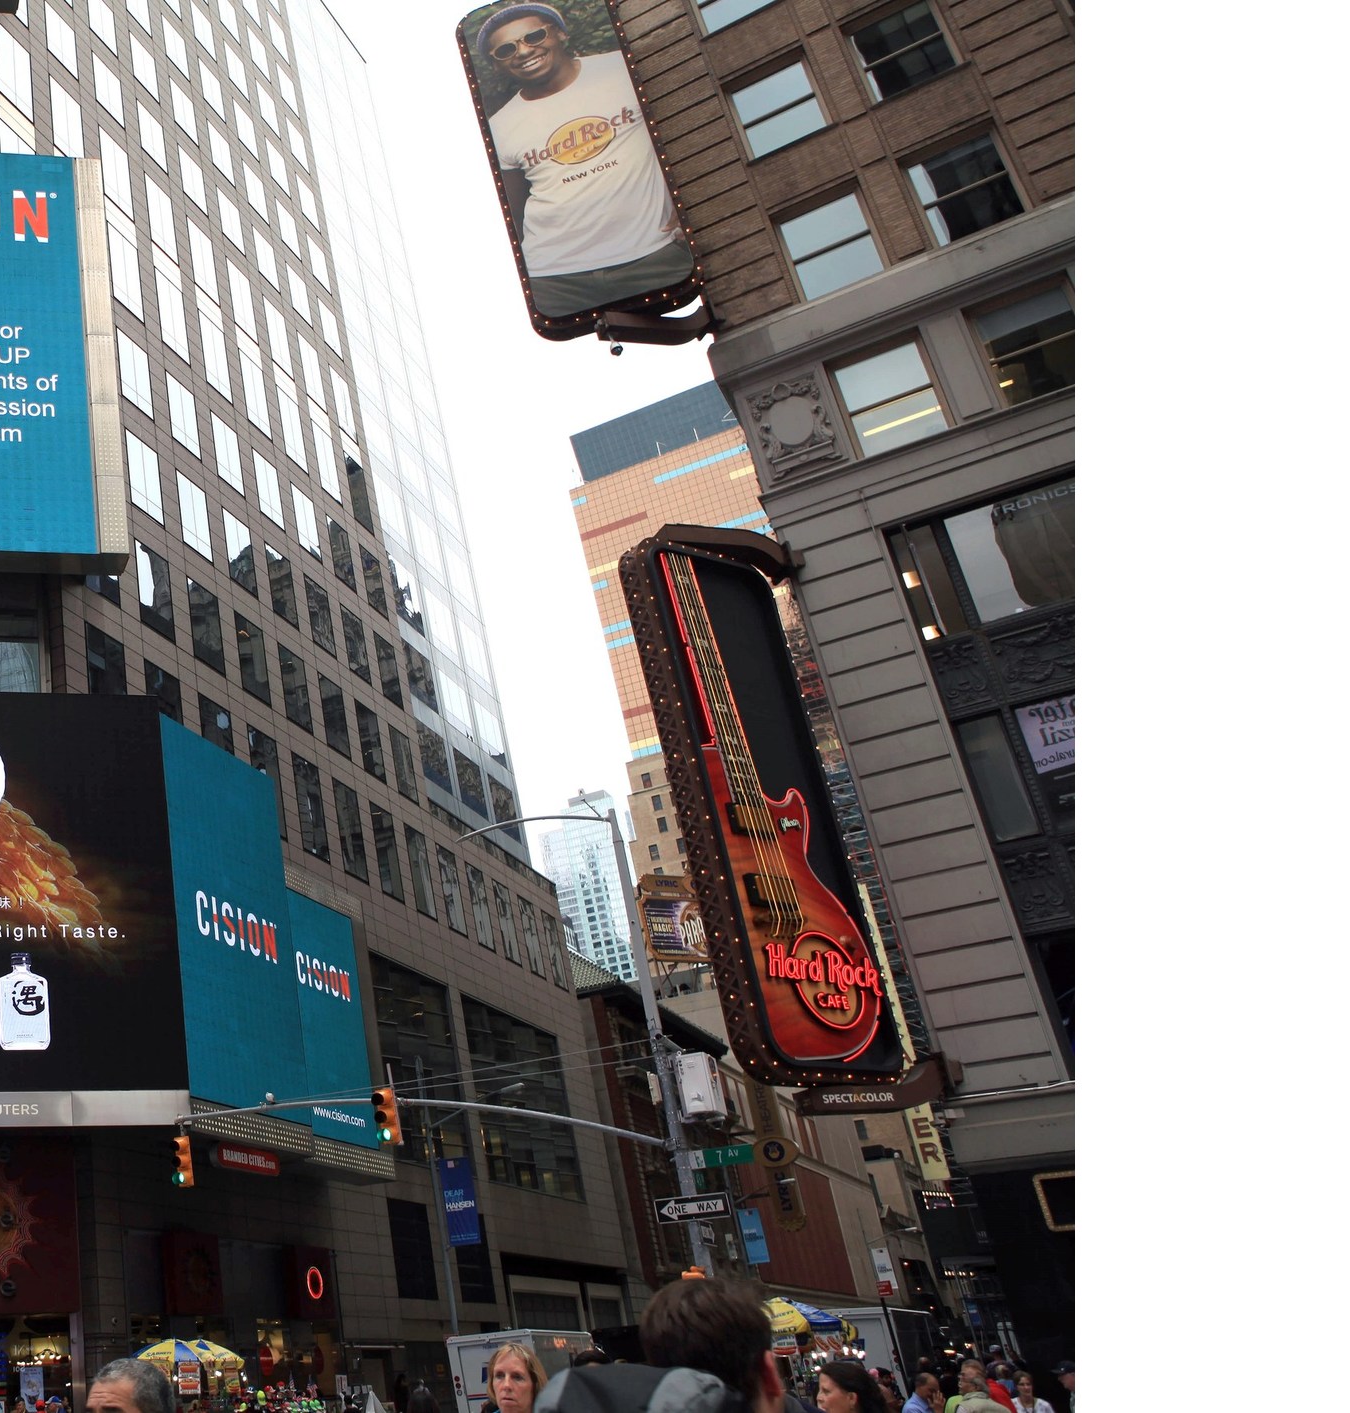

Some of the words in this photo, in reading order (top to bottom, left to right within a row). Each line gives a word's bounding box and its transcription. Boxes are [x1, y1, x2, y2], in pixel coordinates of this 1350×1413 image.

[523, 130, 577, 167] Hard
[578, 106, 636, 143] Rock
[562, 171, 588, 184] NEW
[590, 160, 619, 174] YORK
[36, 374, 59, 392] of
[655, 880, 679, 888] LYRIC
[58, 923, 126, 939] Taste.
[679, 916, 707, 948] PARA
[765, 943, 822, 983] Hard
[825, 951, 883, 996] Rock
[816, 992, 850, 1011] CAFE
[822, 1092, 895, 1104] SPECTACOLOR
[312, 1106, 366, 1128] www.cision.com
[222, 1148, 249, 1164] BRANDED
[716, 1150, 723, 1163] 7
[444, 1189, 464, 1198] DEAR
[446, 1200, 475, 1210] HANSEN
[667, 1204, 688, 1215] ONE
[696, 1201, 719, 1212] WAY
